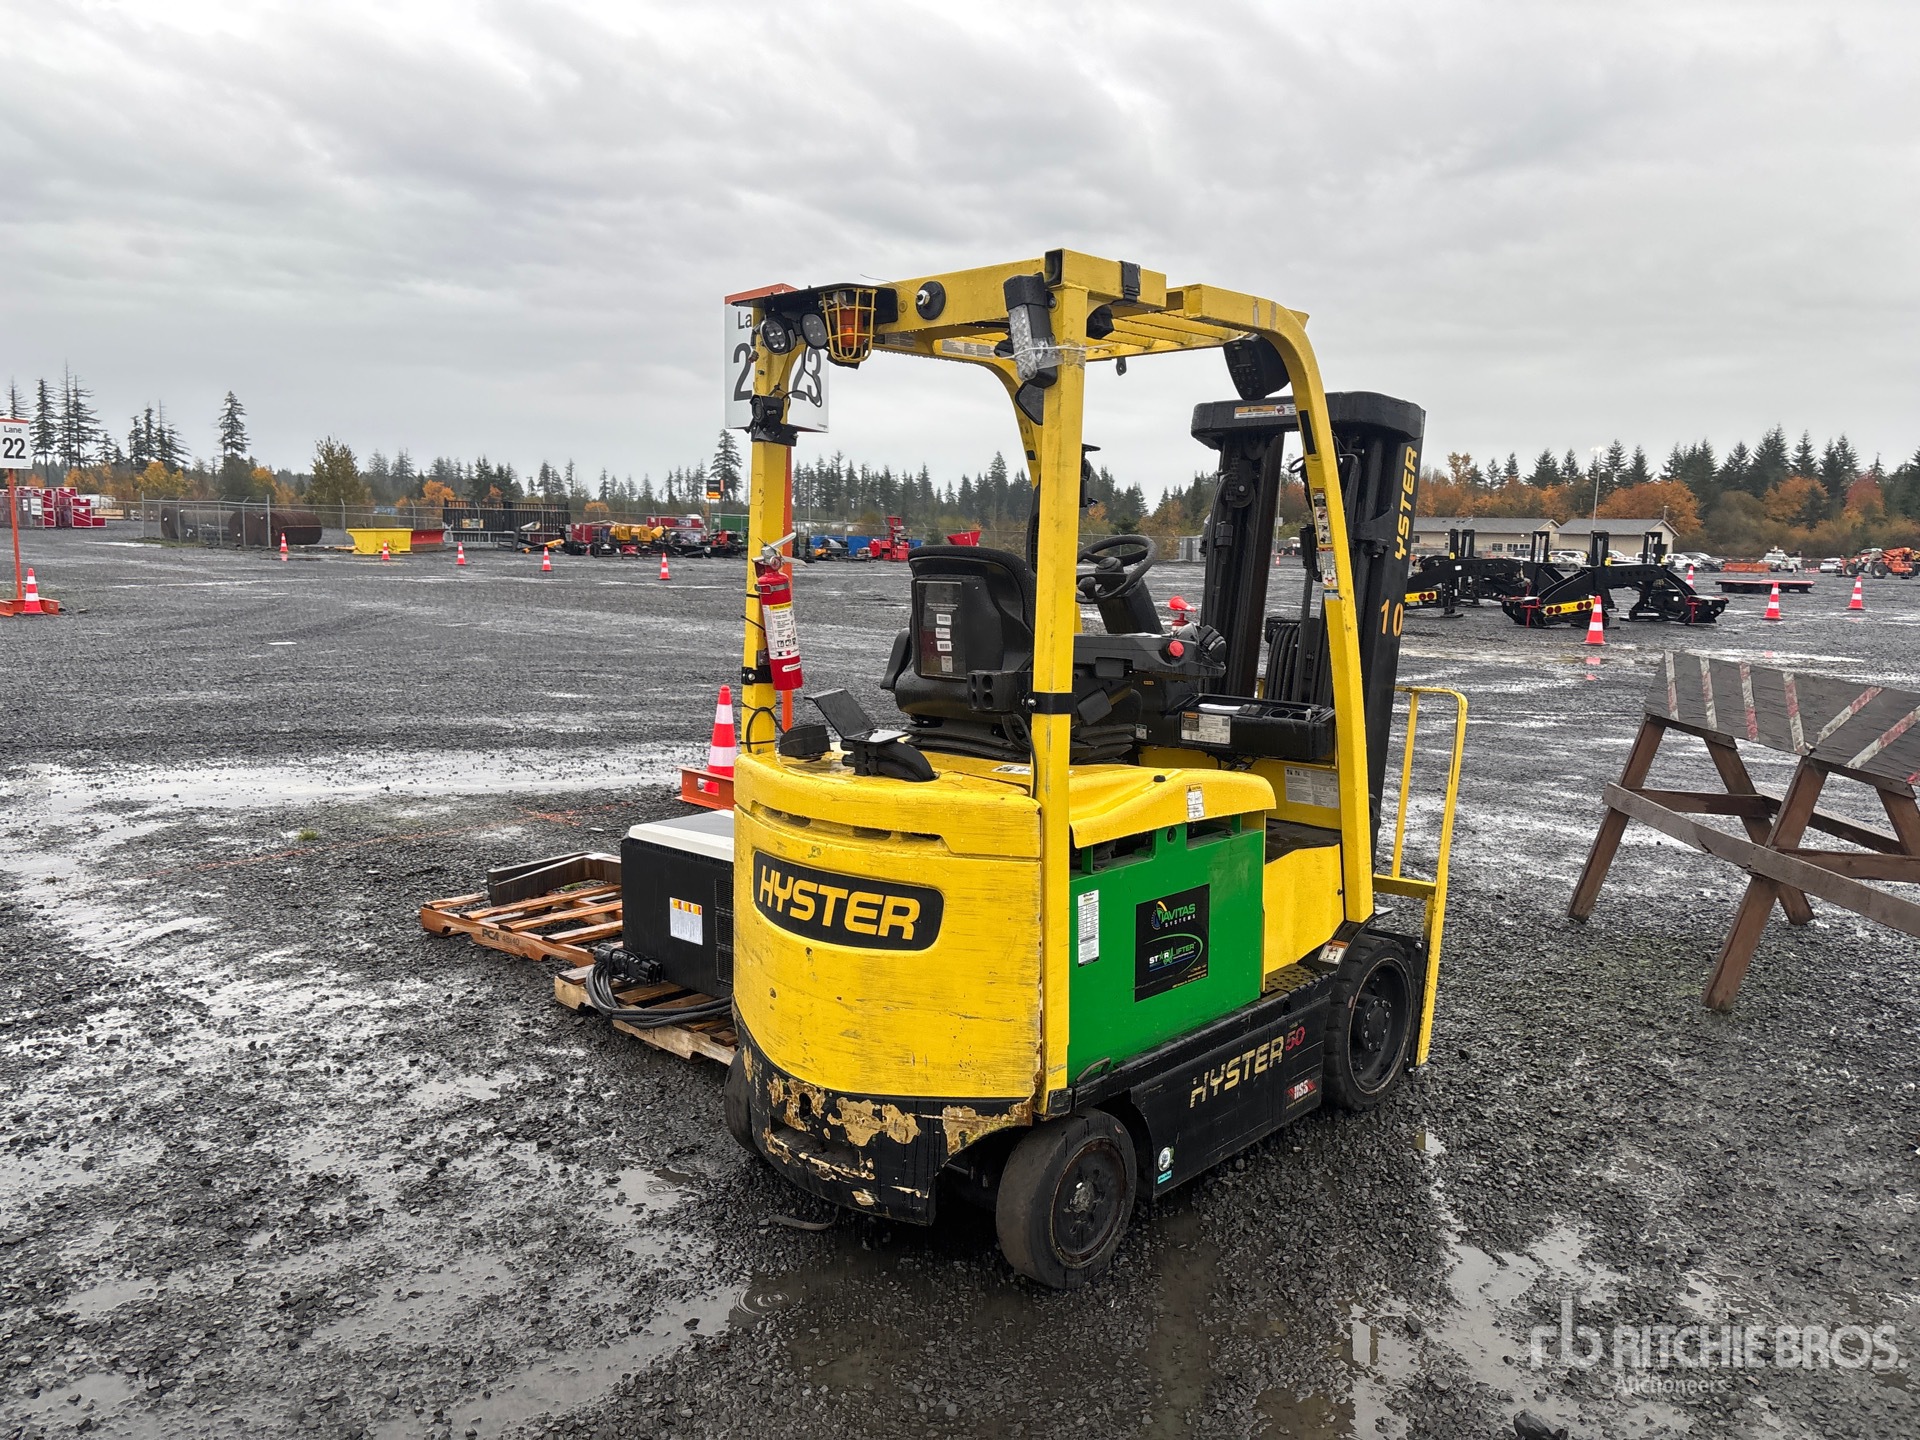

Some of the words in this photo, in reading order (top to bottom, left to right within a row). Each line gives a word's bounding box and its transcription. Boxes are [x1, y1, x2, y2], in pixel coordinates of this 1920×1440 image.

[738, 311, 753, 330] La
[733, 342, 753, 401] 2
[2, 437, 27, 459] 22
[3, 425, 23, 434] Lane
[1380, 599, 1404, 637] 10
[759, 864, 921, 941] HYSTER
[1189, 1036, 1285, 1108] HYSTER
[1285, 1026, 1306, 1052] 50
